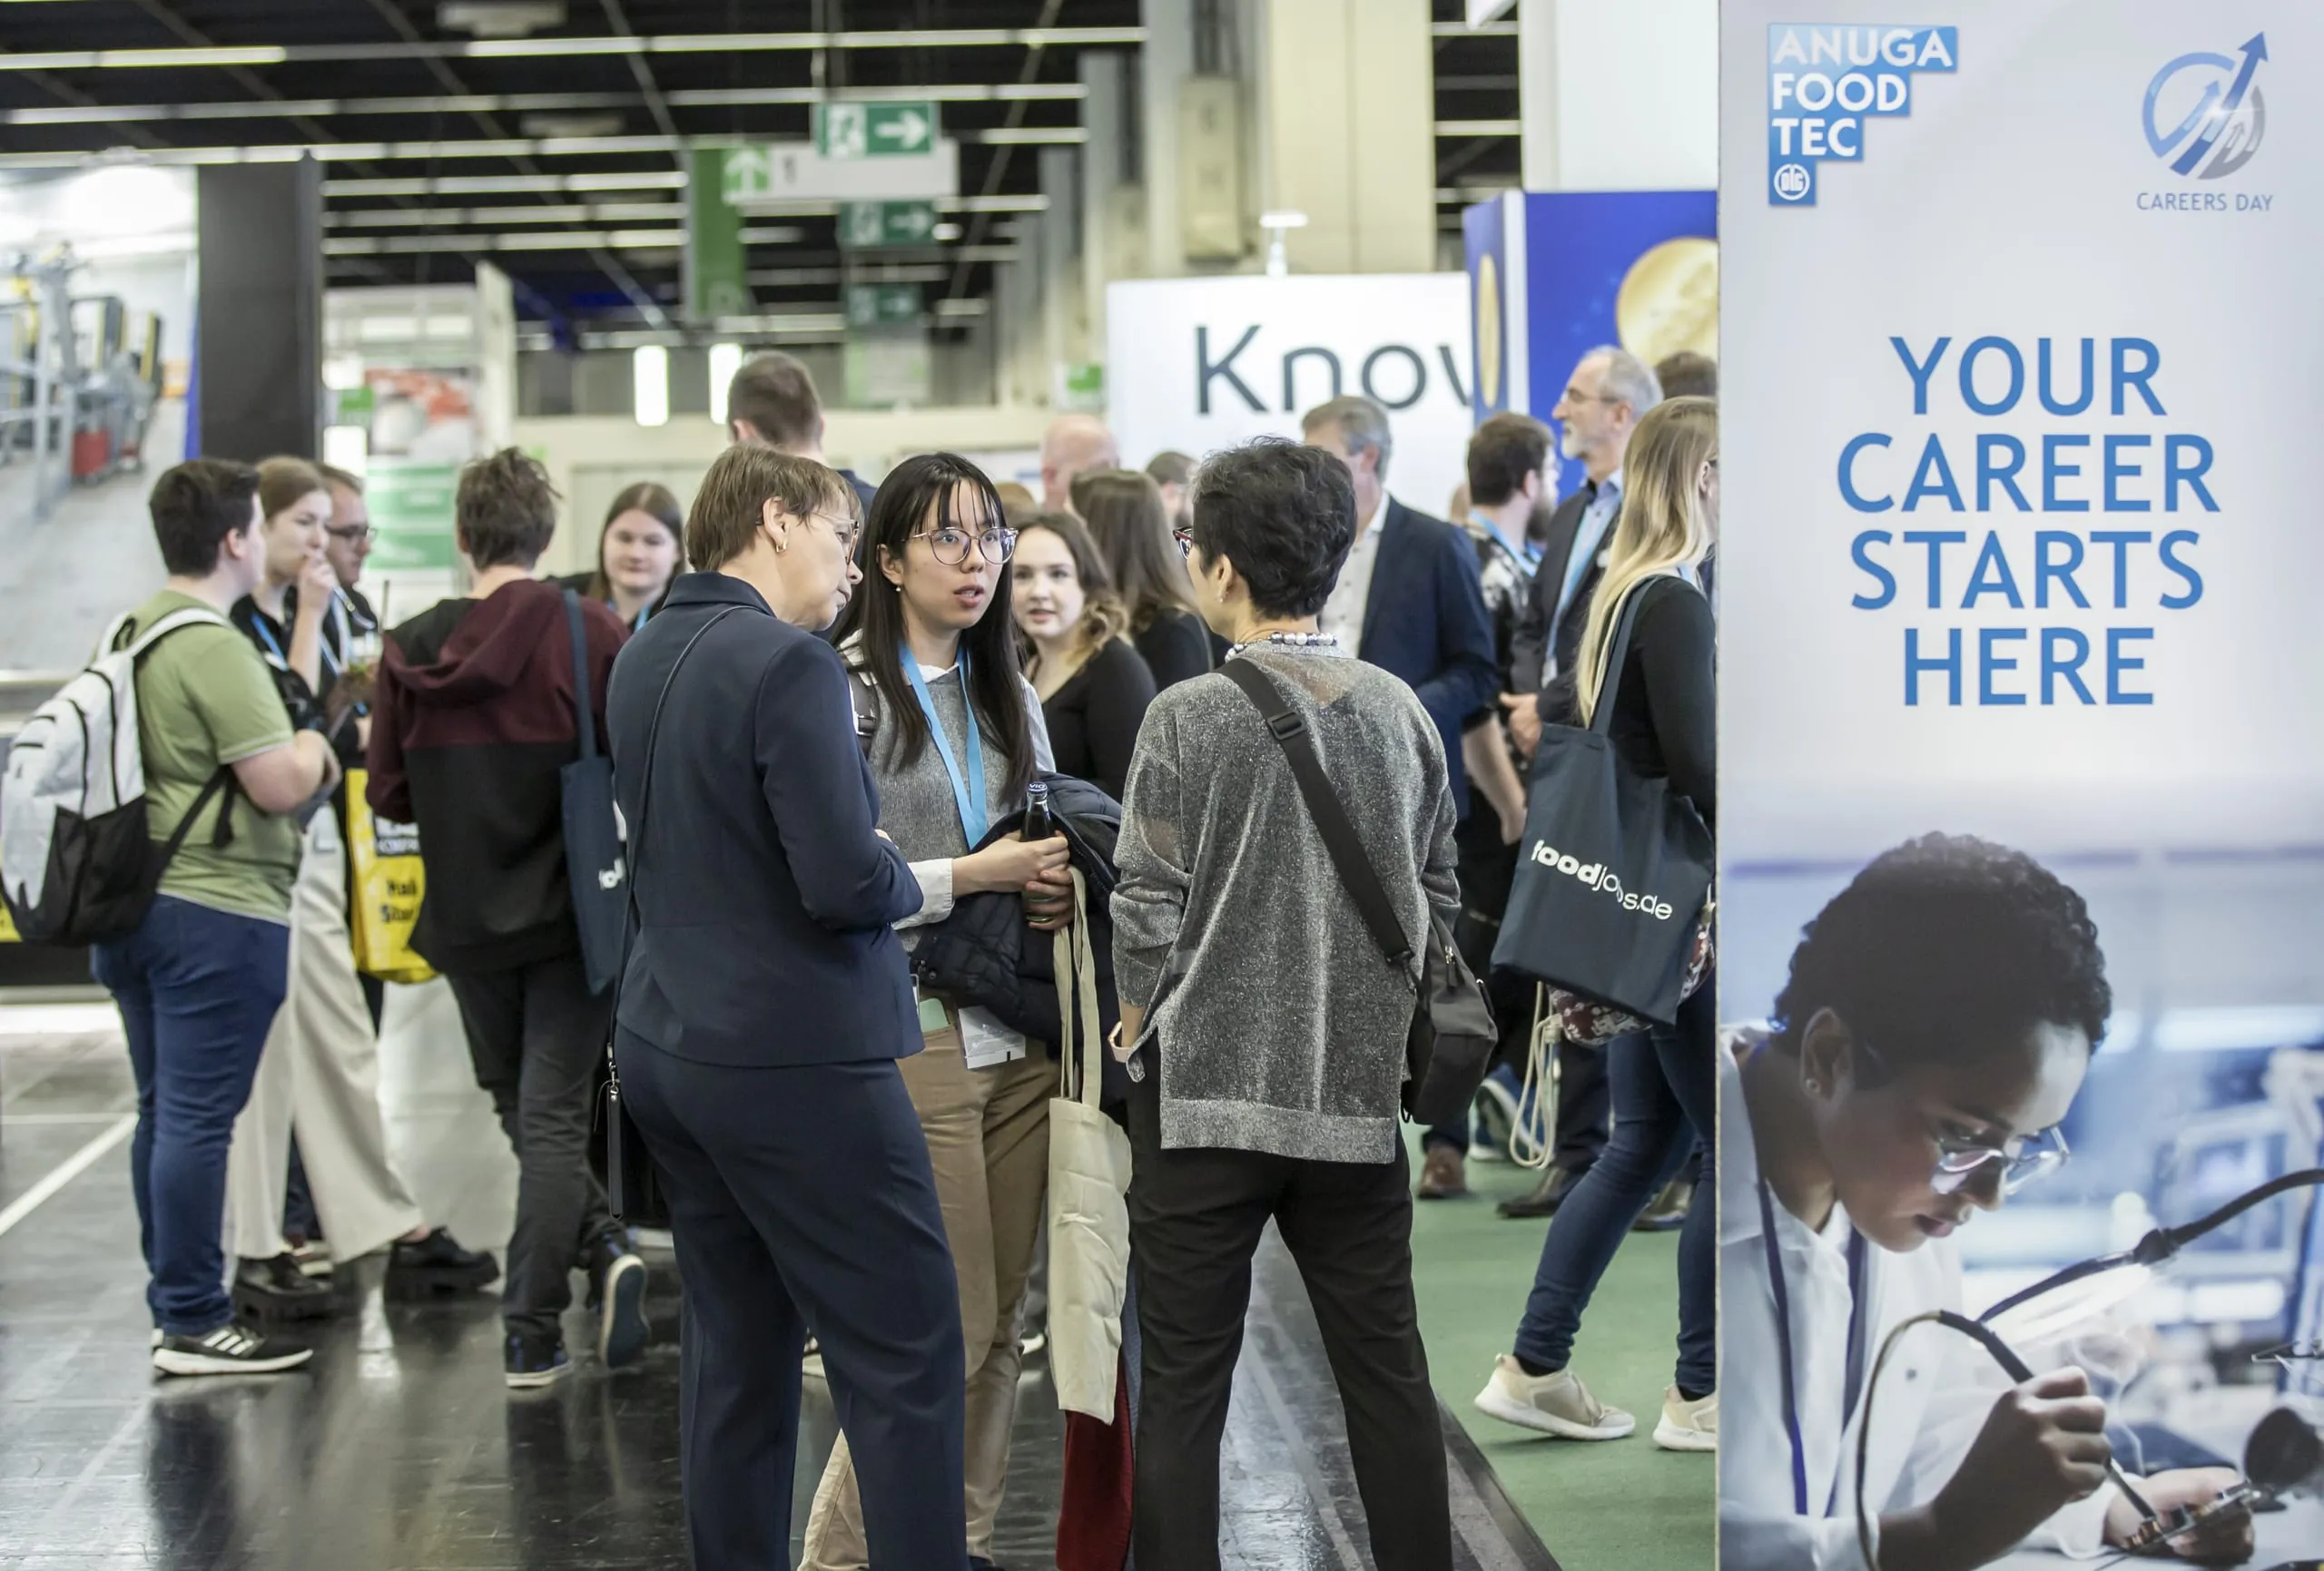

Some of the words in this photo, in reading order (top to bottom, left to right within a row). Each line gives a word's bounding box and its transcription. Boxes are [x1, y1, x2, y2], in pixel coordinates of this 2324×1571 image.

[1772, 28, 1954, 67] ANUGA
[1772, 72, 1907, 112] FOOD
[1771, 117, 1857, 156] TEC
[2136, 192, 2228, 211] CAREERS
[2235, 193, 2274, 211] DAY
[1889, 336, 2168, 417] YOUR
[1837, 432, 2221, 513] CAREER
[1850, 529, 2204, 610] STARTS
[1904, 627, 2157, 706] HERE
